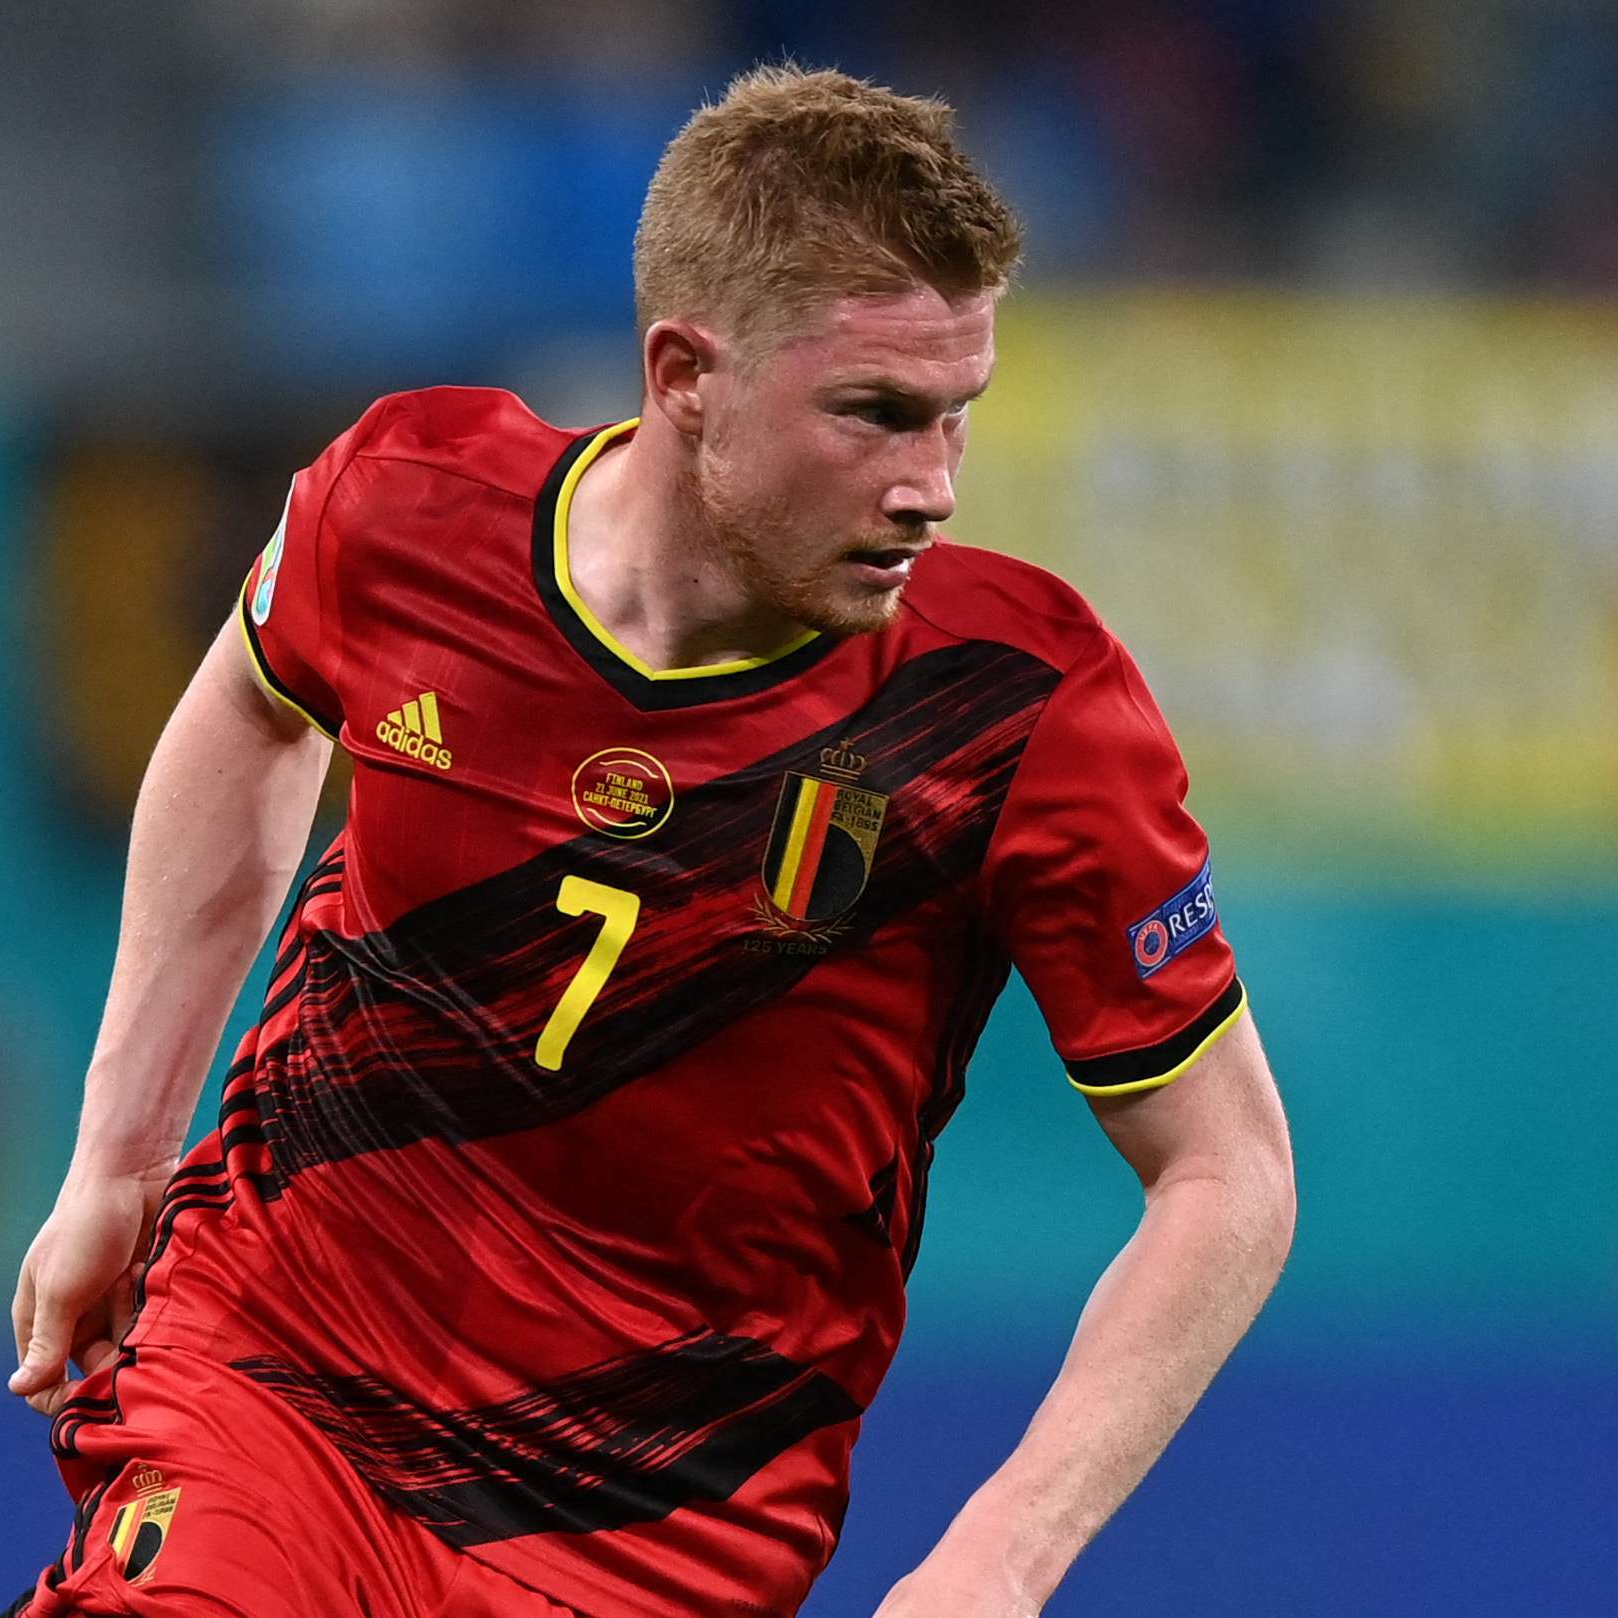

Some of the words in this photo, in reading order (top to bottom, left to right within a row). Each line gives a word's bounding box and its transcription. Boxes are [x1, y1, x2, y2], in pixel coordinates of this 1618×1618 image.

[376, 720, 452, 769] adidas
[606, 772, 643, 791] FINLAND
[595, 782, 605, 794] 21
[606, 785, 629, 800] JUNE
[629, 790, 649, 805] 2021
[837, 789, 872, 807] ROYAL
[835, 801, 882, 821] BELGIAN
[743, 939, 773, 954] 125
[776, 941, 828, 956] YEARS
[535, 874, 641, 1072] 7
